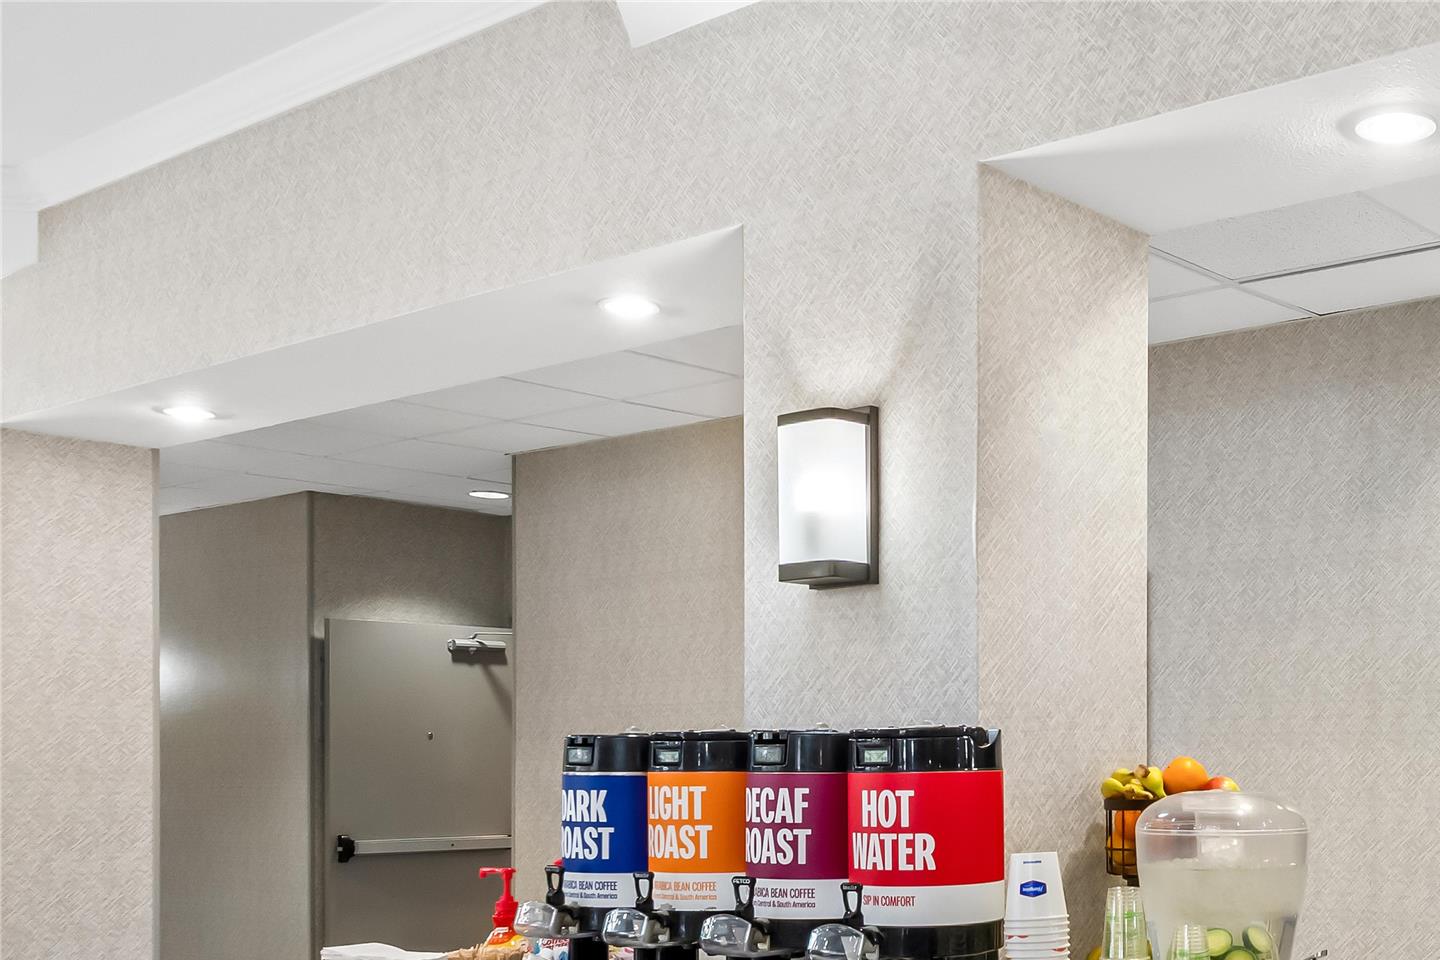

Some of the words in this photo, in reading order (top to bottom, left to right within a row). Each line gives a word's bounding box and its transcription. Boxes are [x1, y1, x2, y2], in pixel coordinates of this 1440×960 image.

[561, 789, 608, 823] DARK
[649, 785, 707, 820] LIGHT
[745, 787, 810, 824] DECAF
[861, 789, 915, 828] HOT
[648, 824, 713, 860] ROAST
[852, 832, 937, 871] WATER
[579, 880, 593, 890] BEAN
[594, 881, 618, 891] COFFEE
[674, 881, 690, 892] BEAN
[692, 881, 717, 892] COFFEE
[771, 887, 788, 899] BEAN
[790, 888, 816, 899] COFFEE
[863, 894, 872, 905] SIP
[873, 895, 879, 906] IN
[881, 896, 915, 907] COMFORT
[792, 901, 816, 909] America
